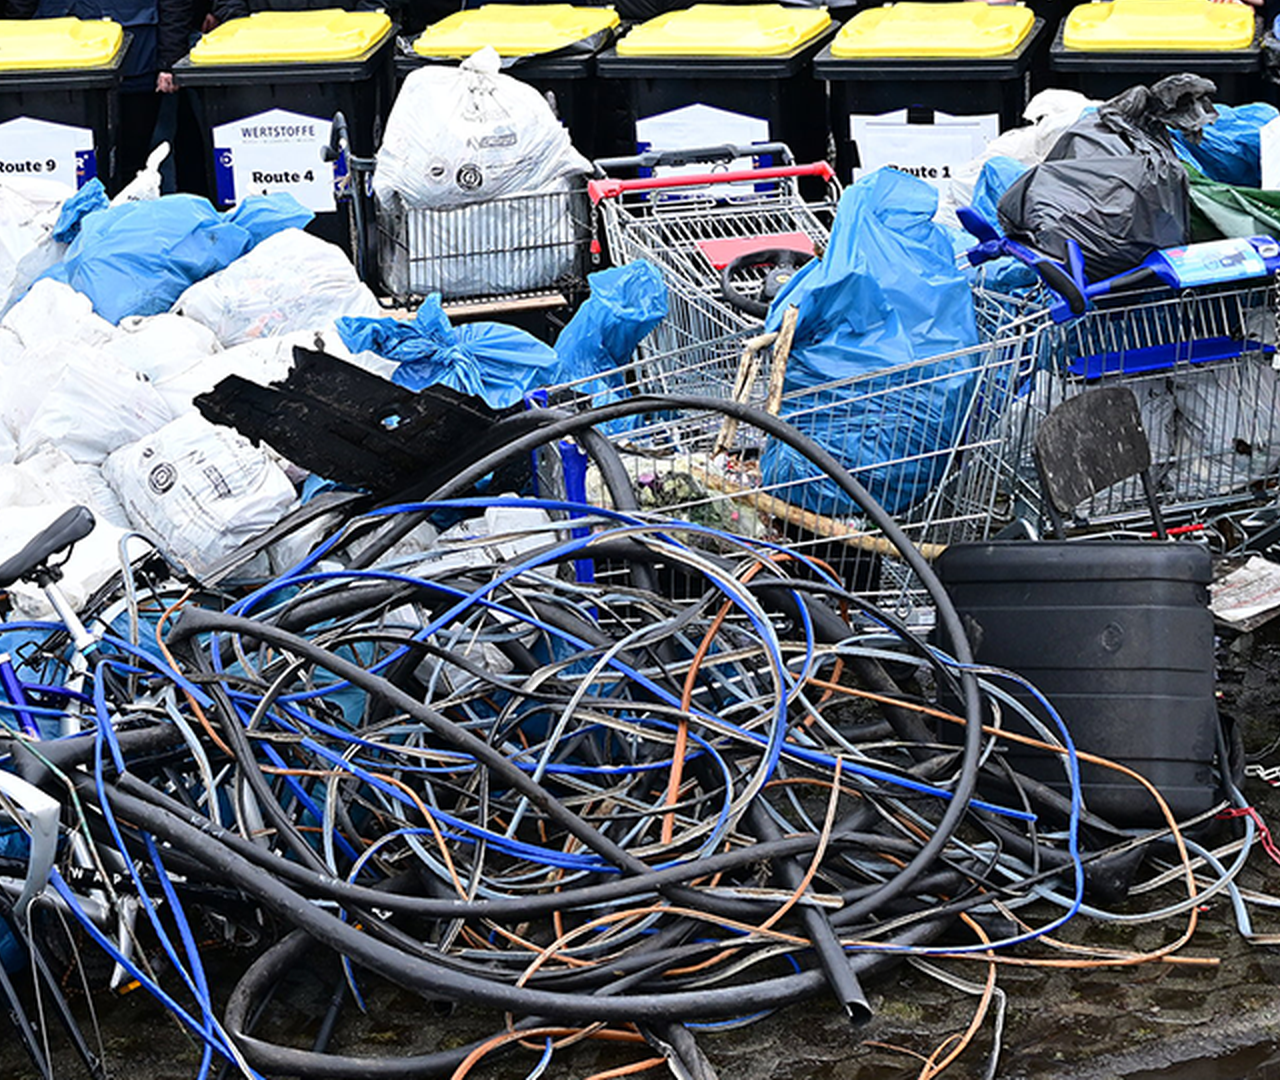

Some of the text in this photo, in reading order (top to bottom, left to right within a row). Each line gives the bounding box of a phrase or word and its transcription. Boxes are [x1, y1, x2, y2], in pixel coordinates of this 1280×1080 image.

[241, 125, 315, 138] WERTSTOFFE
[46, 159, 56, 172] 9
[942, 166, 951, 178] 1
[252, 170, 314, 183] Route 4
